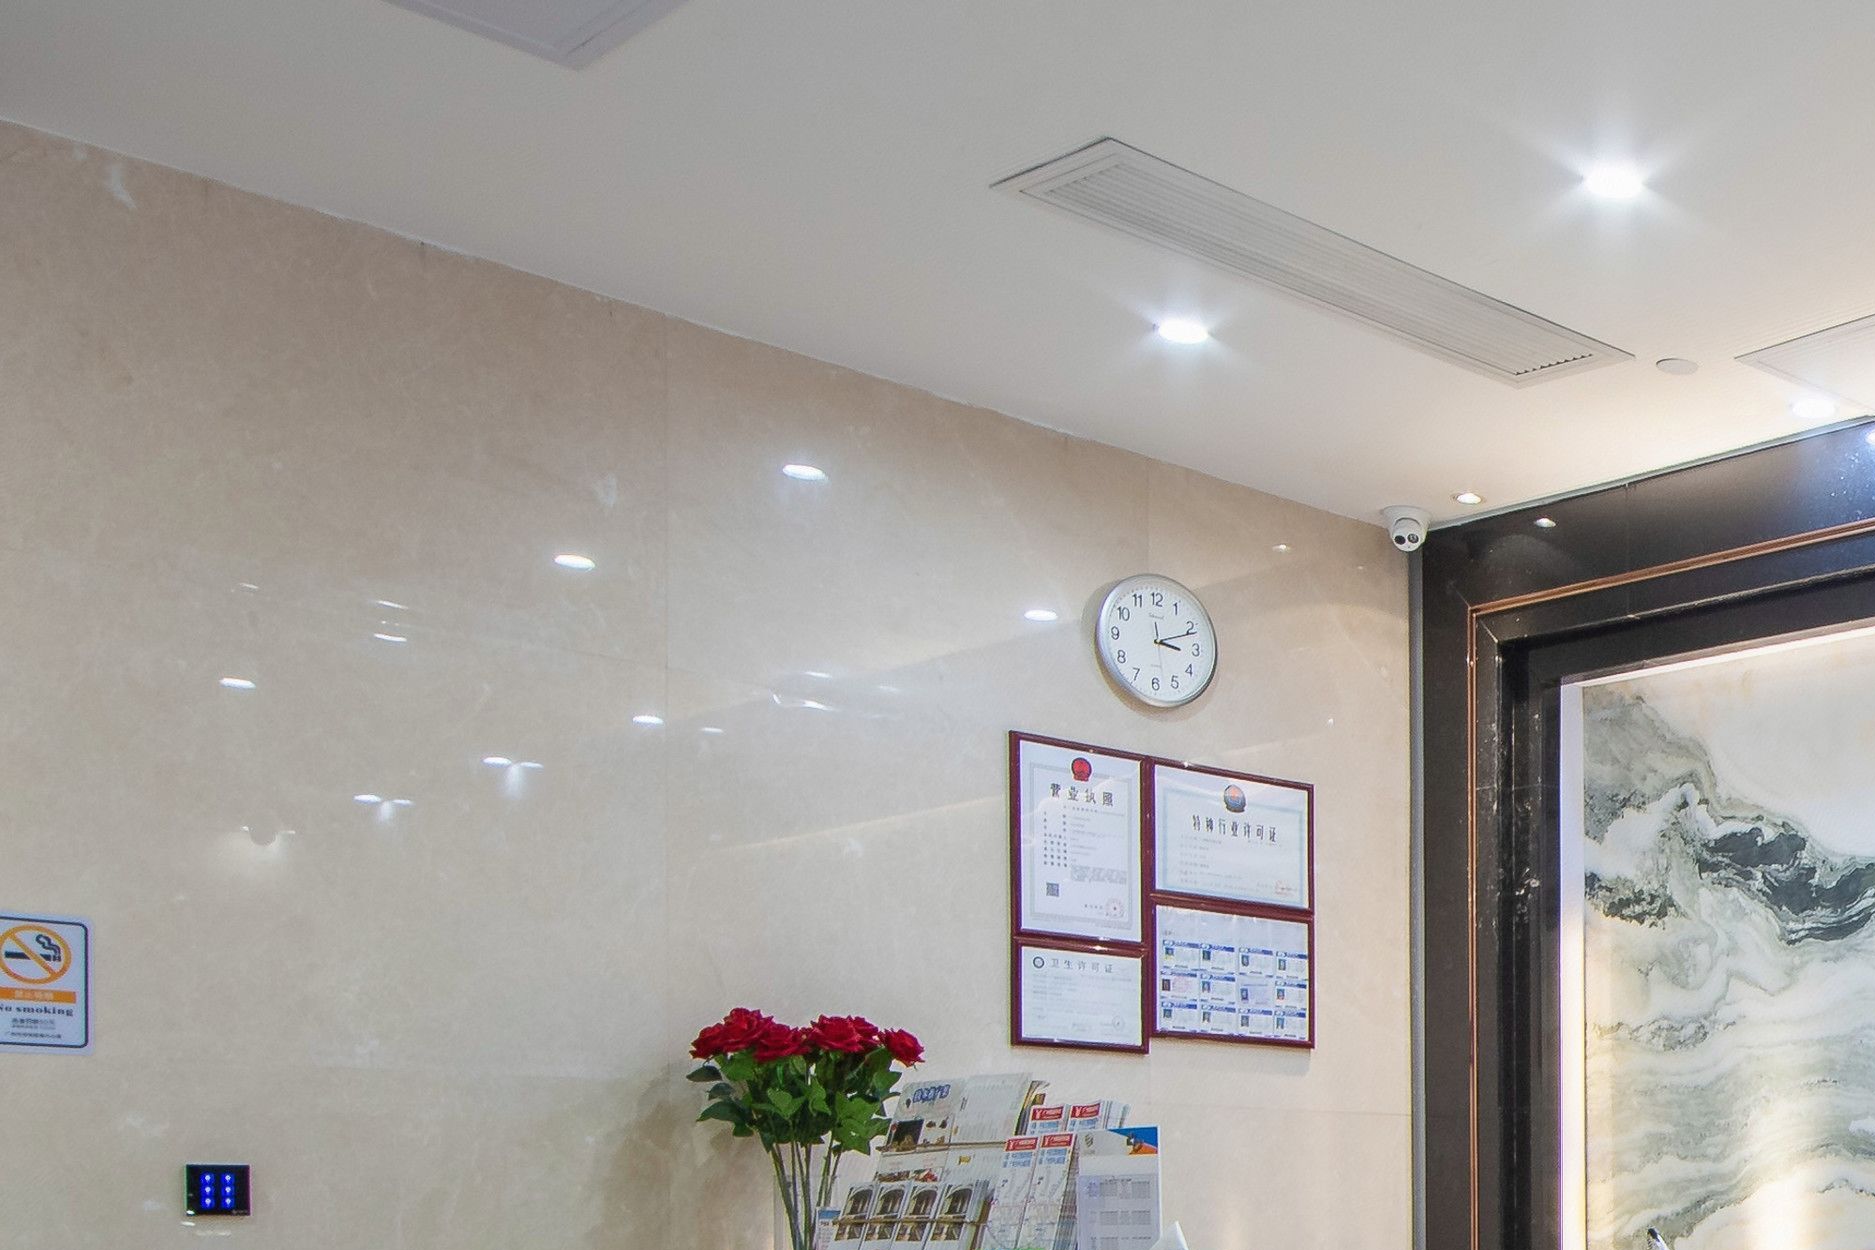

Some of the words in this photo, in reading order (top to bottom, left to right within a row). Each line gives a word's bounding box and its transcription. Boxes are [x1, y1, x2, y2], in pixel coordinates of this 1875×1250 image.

[1132, 593, 1142, 608] 11
[1151, 592, 1163, 607] 12
[1117, 606, 1130, 621] 10
[1173, 602, 1178, 615] 1
[1111, 626, 1120, 640] 9
[1186, 620, 1194, 635] 2
[1117, 650, 1126, 664] 8
[1192, 643, 1200, 657] 3
[1132, 667, 1140, 681] 7
[1185, 663, 1193, 677] 4
[1151, 677, 1160, 691] 6
[1170, 675, 1179, 689] 5
[1050, 782, 1113, 806] 营业执照
[1051, 958, 1112, 973] 卫生许可证
[16, 1006, 73, 1017] smoking
